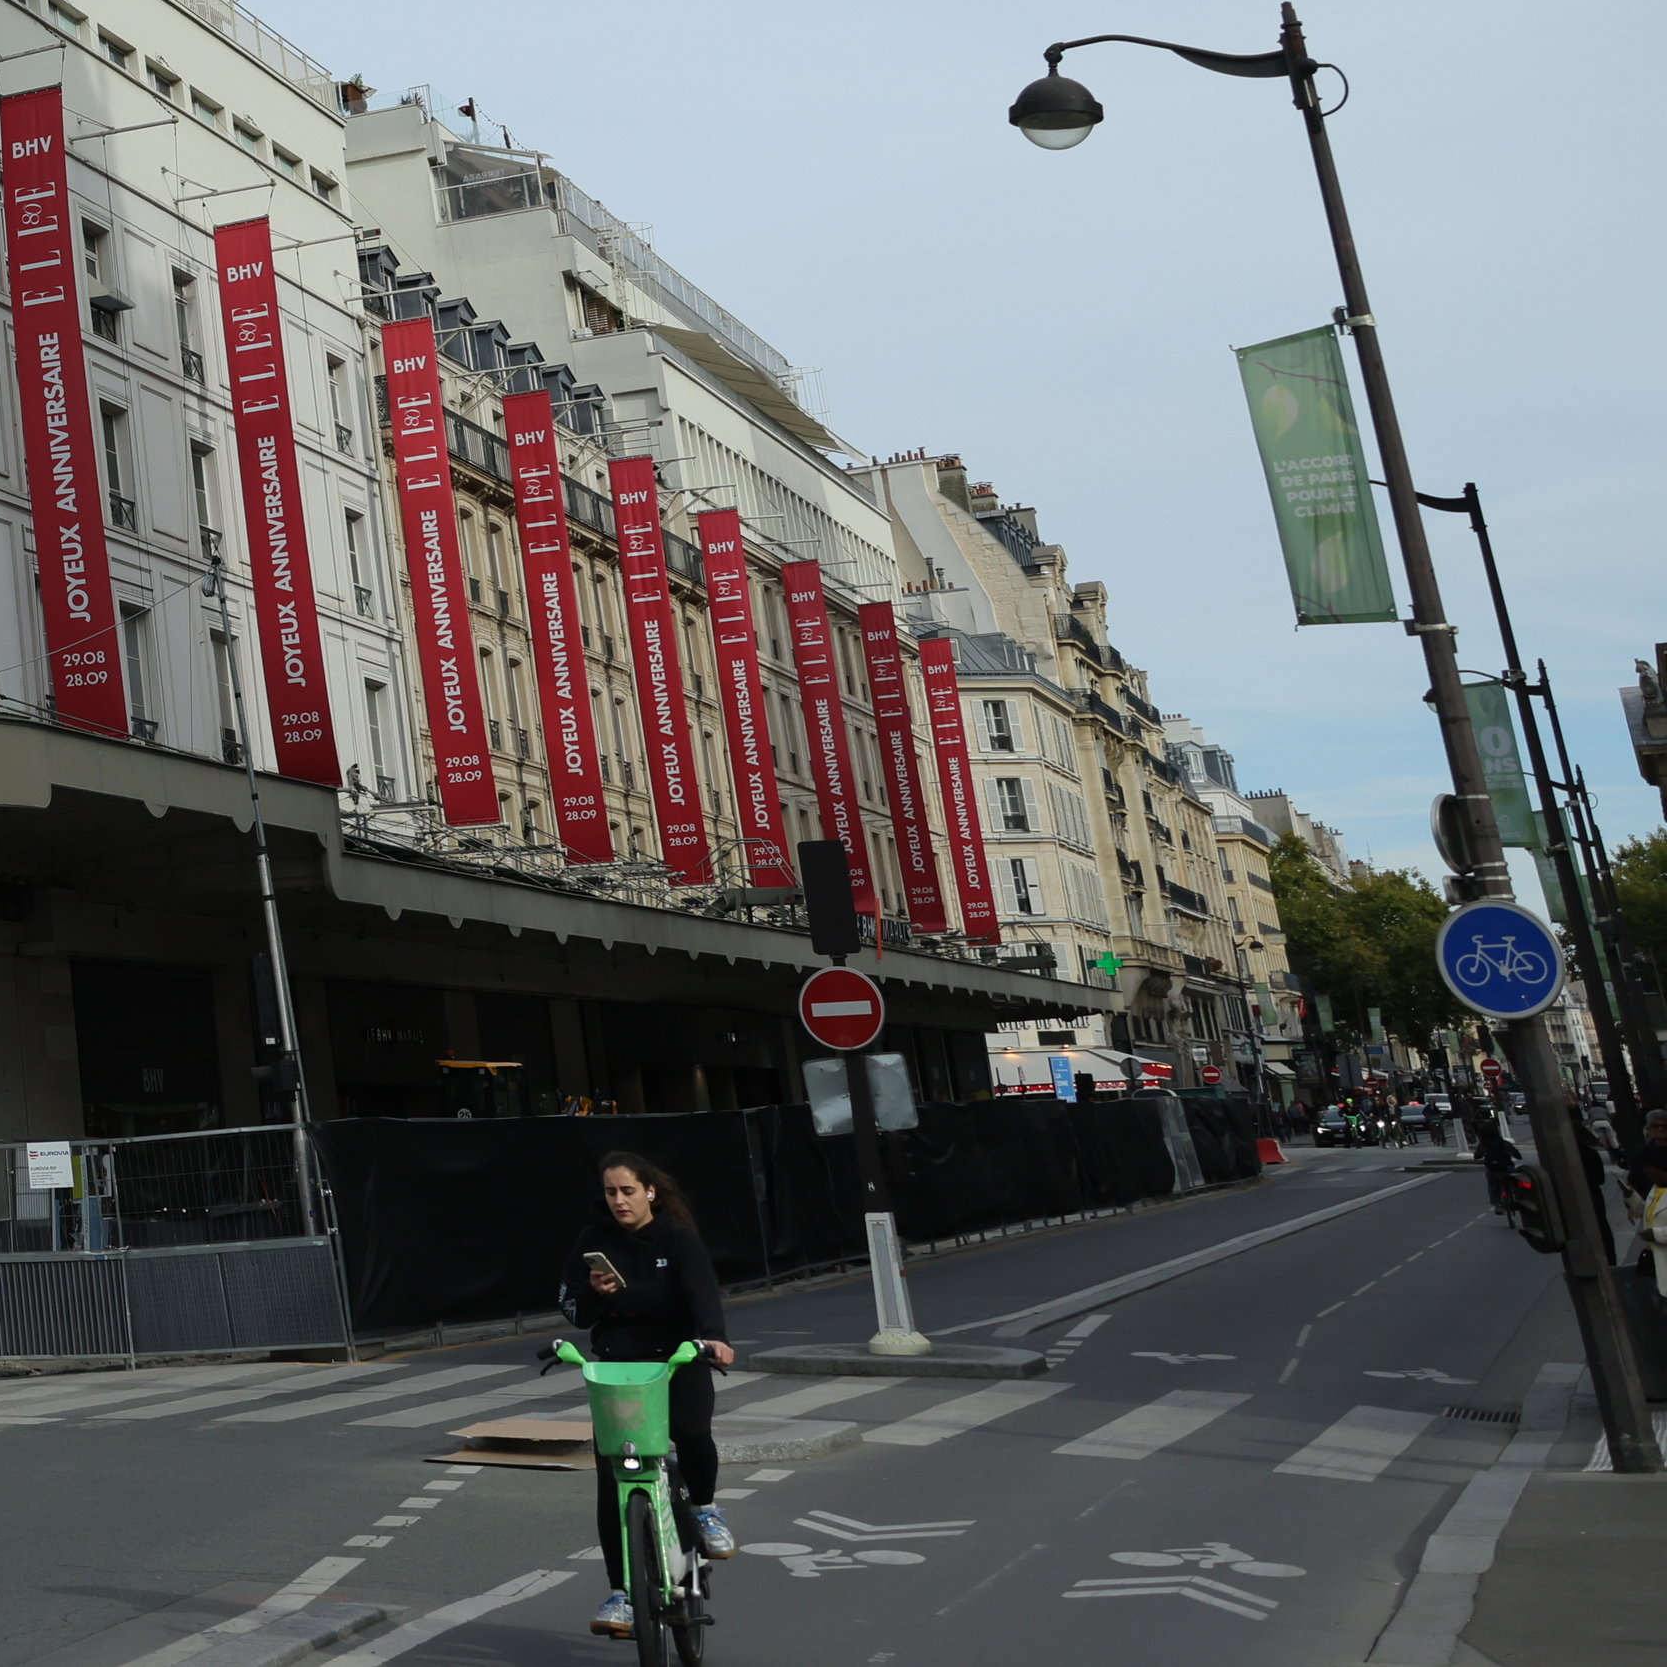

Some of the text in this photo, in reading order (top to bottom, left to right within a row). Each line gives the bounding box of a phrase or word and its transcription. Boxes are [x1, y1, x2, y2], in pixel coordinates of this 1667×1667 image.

[13, 135, 51, 158] BHV
[227, 262, 262, 282] BHV
[394, 356, 425, 373] BHV
[39, 332, 90, 622] JOYEUX ANNIVERSAIRE
[1280, 475, 1304, 487] DE
[1287, 488, 1335, 502] POUR
[258, 436, 306, 687] JOYEUX ANNIVERSAIRE
[421, 510, 466, 733] JOYEUX ANNIVERSAIRE
[63, 651, 105, 666] 29.08
[66, 671, 107, 686] 28.09
[542, 573, 583, 776] JOYEUX ANNIVERSAIRE
[282, 712, 319, 725] 29.08
[645, 620, 685, 805] JOYEUX ANNIVERSAIRE
[285, 729, 322, 743] 28.09
[734, 660, 770, 829] JOYEUX ANNIVERSAIRE
[446, 755, 479, 767] 29.08
[1484, 757, 1518, 773] NS
[448, 771, 481, 783] 28.09
[141, 1068, 163, 1093] BHV
